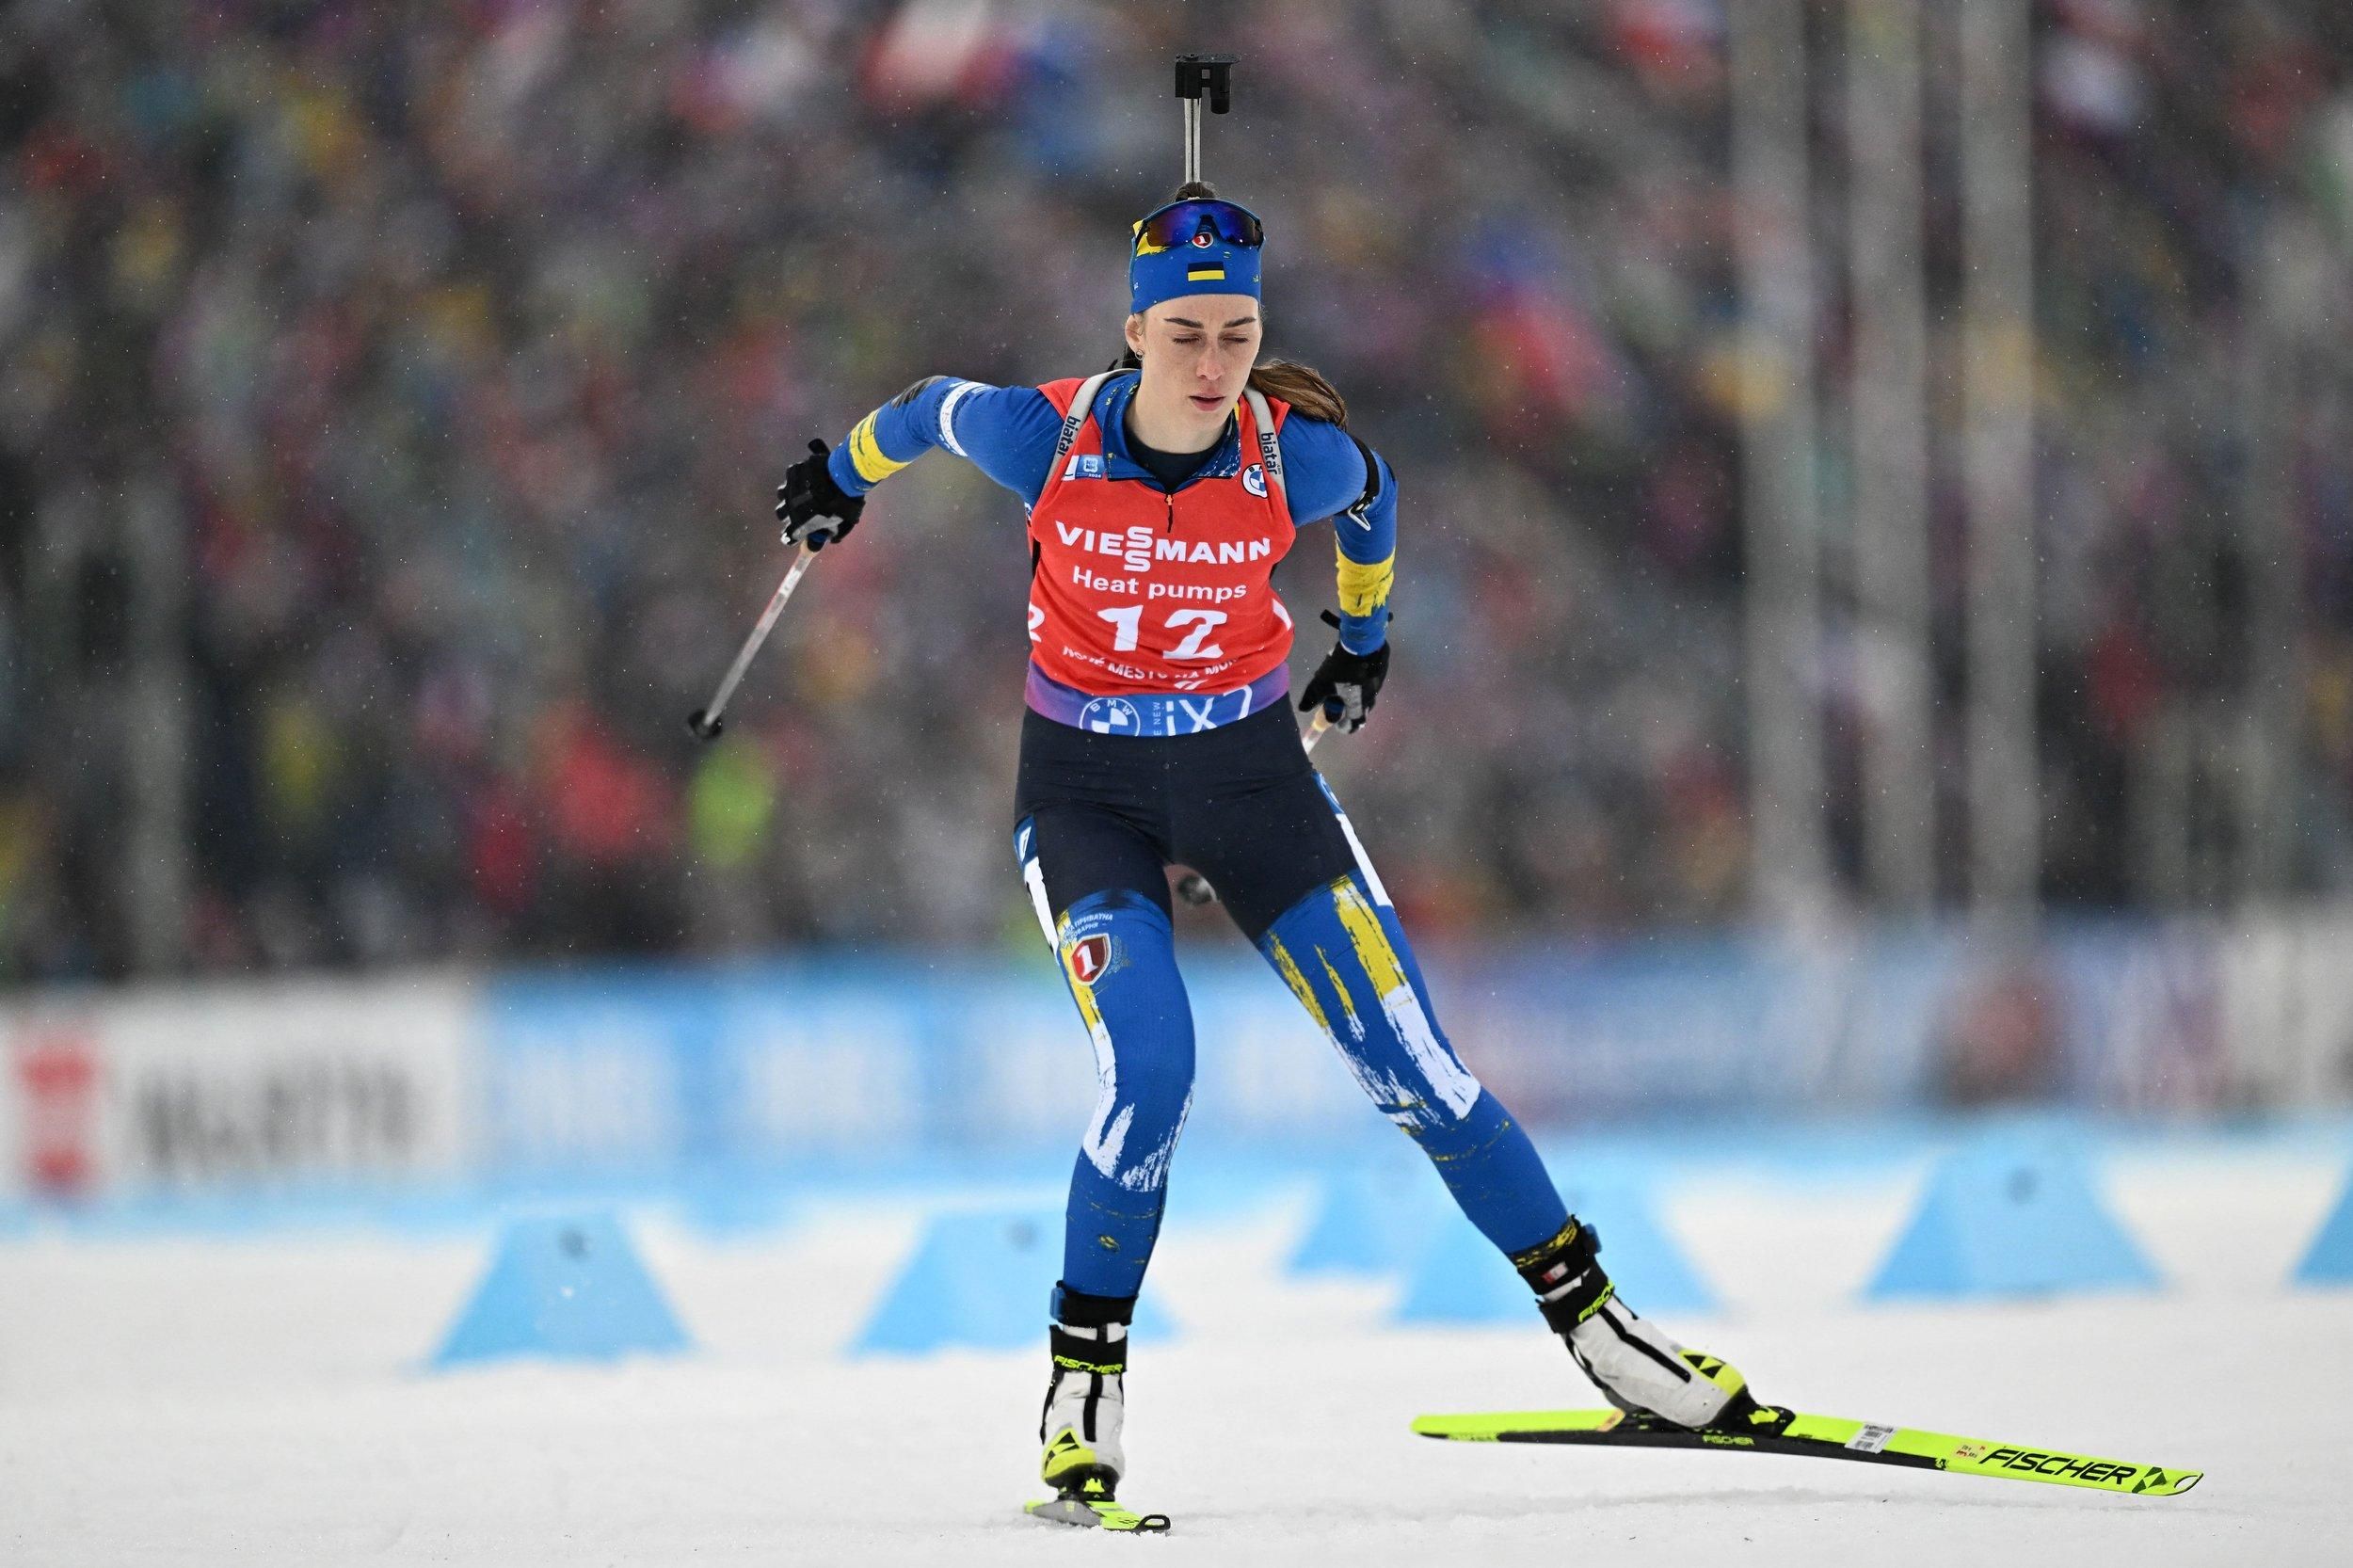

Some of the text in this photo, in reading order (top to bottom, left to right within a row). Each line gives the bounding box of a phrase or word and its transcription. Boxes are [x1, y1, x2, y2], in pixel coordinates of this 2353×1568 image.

[1261, 432, 1278, 475] biatar
[1055, 520, 1271, 572] VIESSMANN
[1072, 566, 1247, 603] Heat pumps
[1097, 604, 1227, 660] 12
[1090, 699, 1133, 715] BMW
[1153, 702, 1161, 725] NEW
[1077, 944, 1099, 978] 1
[1054, 1354, 1124, 1374] FISCHER
[1977, 1448, 2137, 1485] FISCHER
